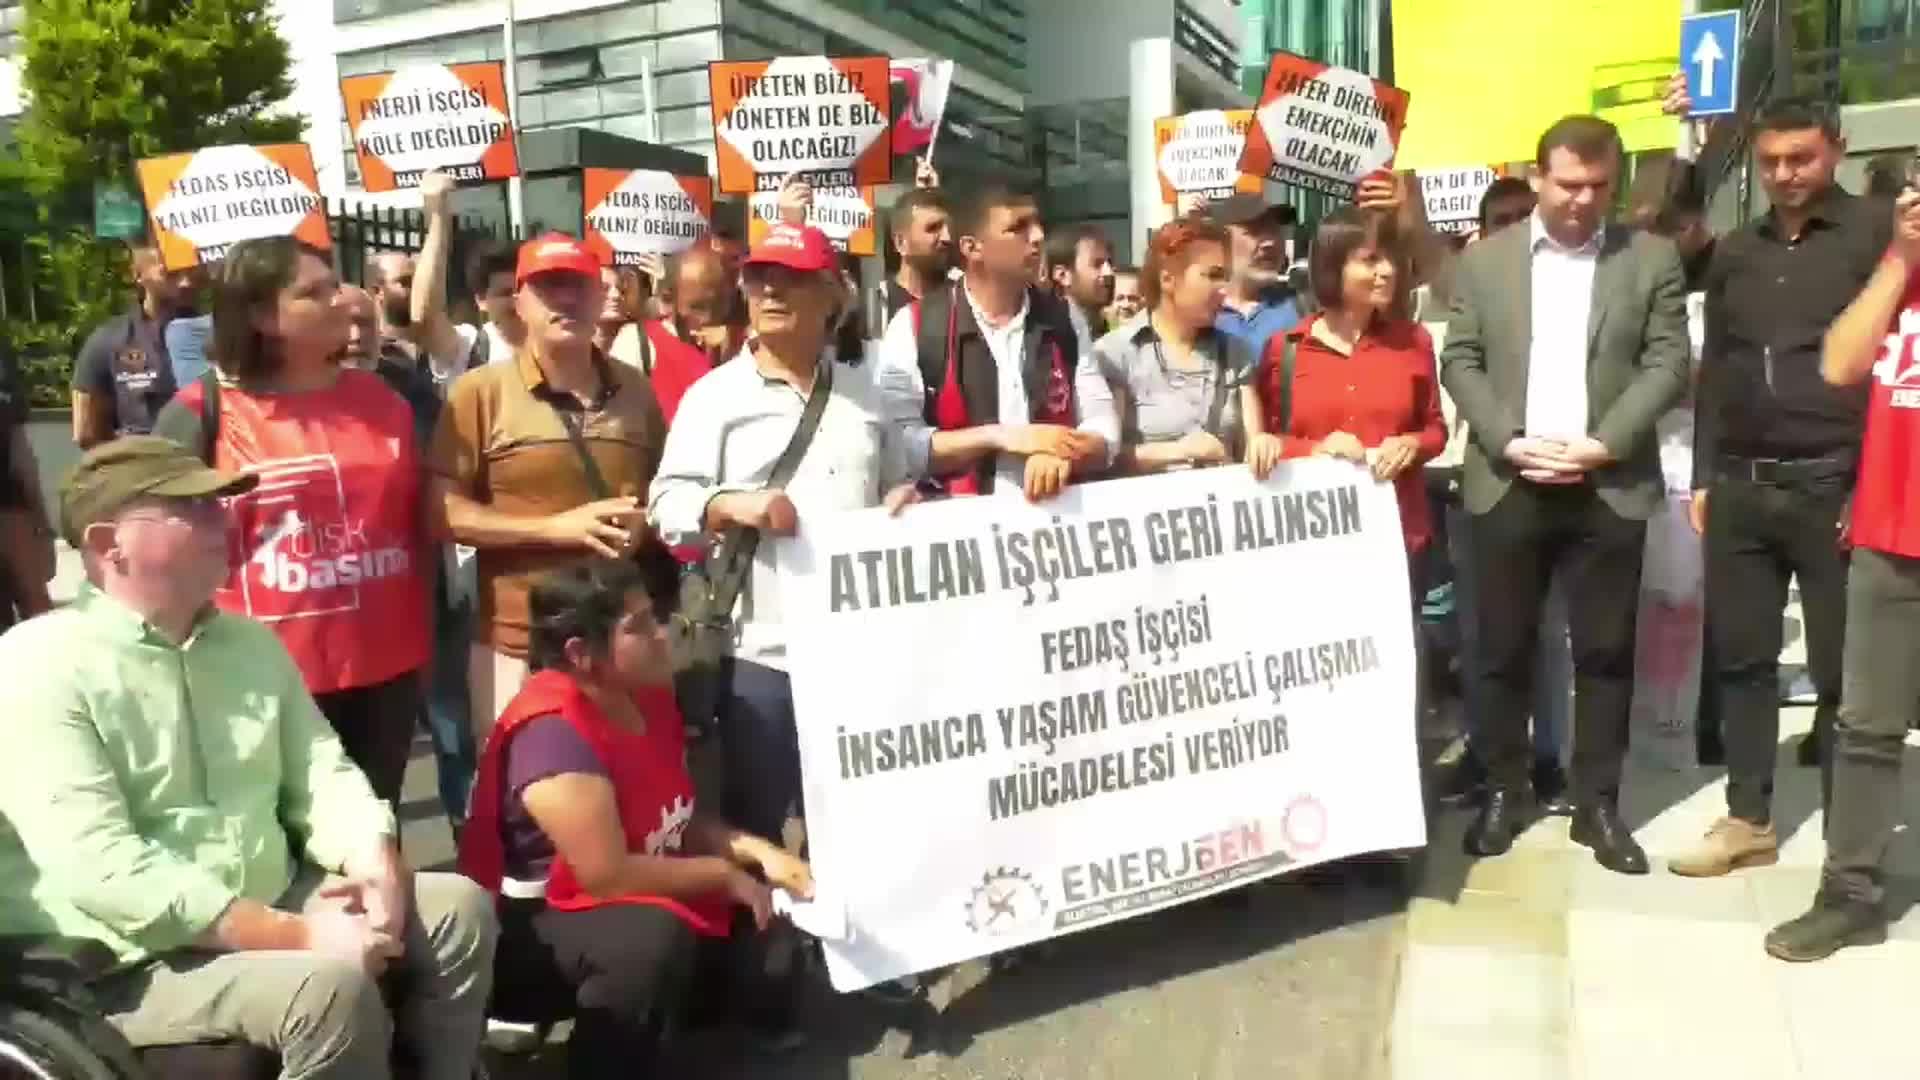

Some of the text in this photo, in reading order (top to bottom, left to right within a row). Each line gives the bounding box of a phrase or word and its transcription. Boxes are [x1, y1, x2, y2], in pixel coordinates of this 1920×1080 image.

[725, 97, 881, 131] YÖNETEN DE BİZ
[729, 67, 865, 98] ÜRETEN BİZİZ
[753, 132, 857, 162] OLACAĞIZ!
[1285, 105, 1378, 150] EMEKÇİNİN
[830, 484, 1363, 613] ATILAN İŞÇİLER GERİ ALINSIN
[1041, 593, 1213, 674] FEDAŞ İŞÇİSİ
[837, 634, 1382, 781] İNSANCA YAŞAM GÜVENCELİ ÇALIŞMA
[988, 713, 1290, 822] MÜCADELESİ VERİYOR
